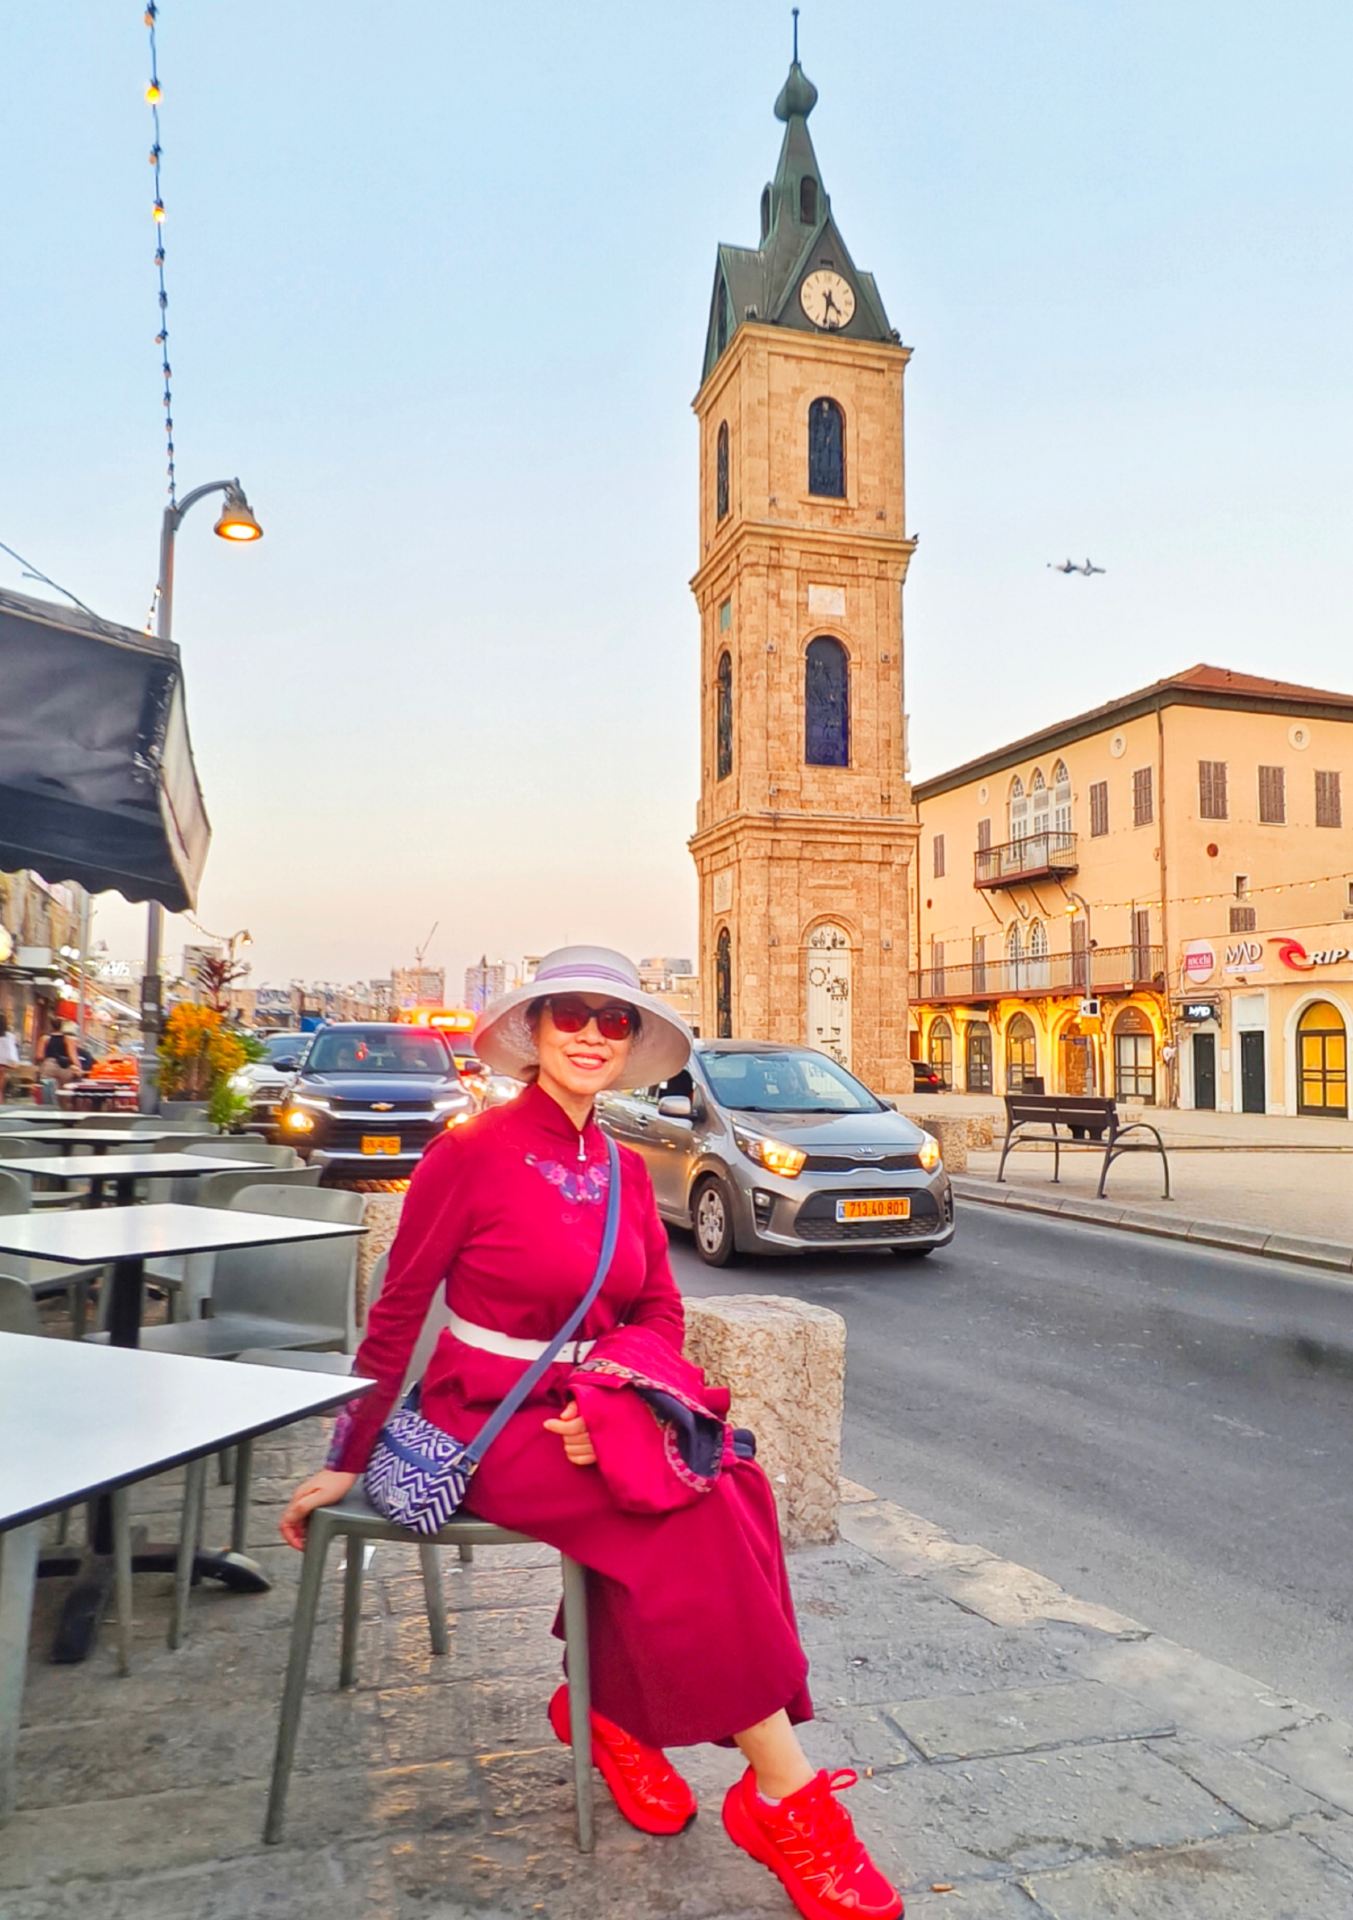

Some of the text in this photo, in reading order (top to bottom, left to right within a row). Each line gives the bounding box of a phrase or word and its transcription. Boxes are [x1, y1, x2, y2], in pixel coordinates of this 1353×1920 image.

[1226, 941, 1262, 964] MAD
[1306, 949, 1348, 965] RIP
[1188, 1005, 1212, 1017] MAD
